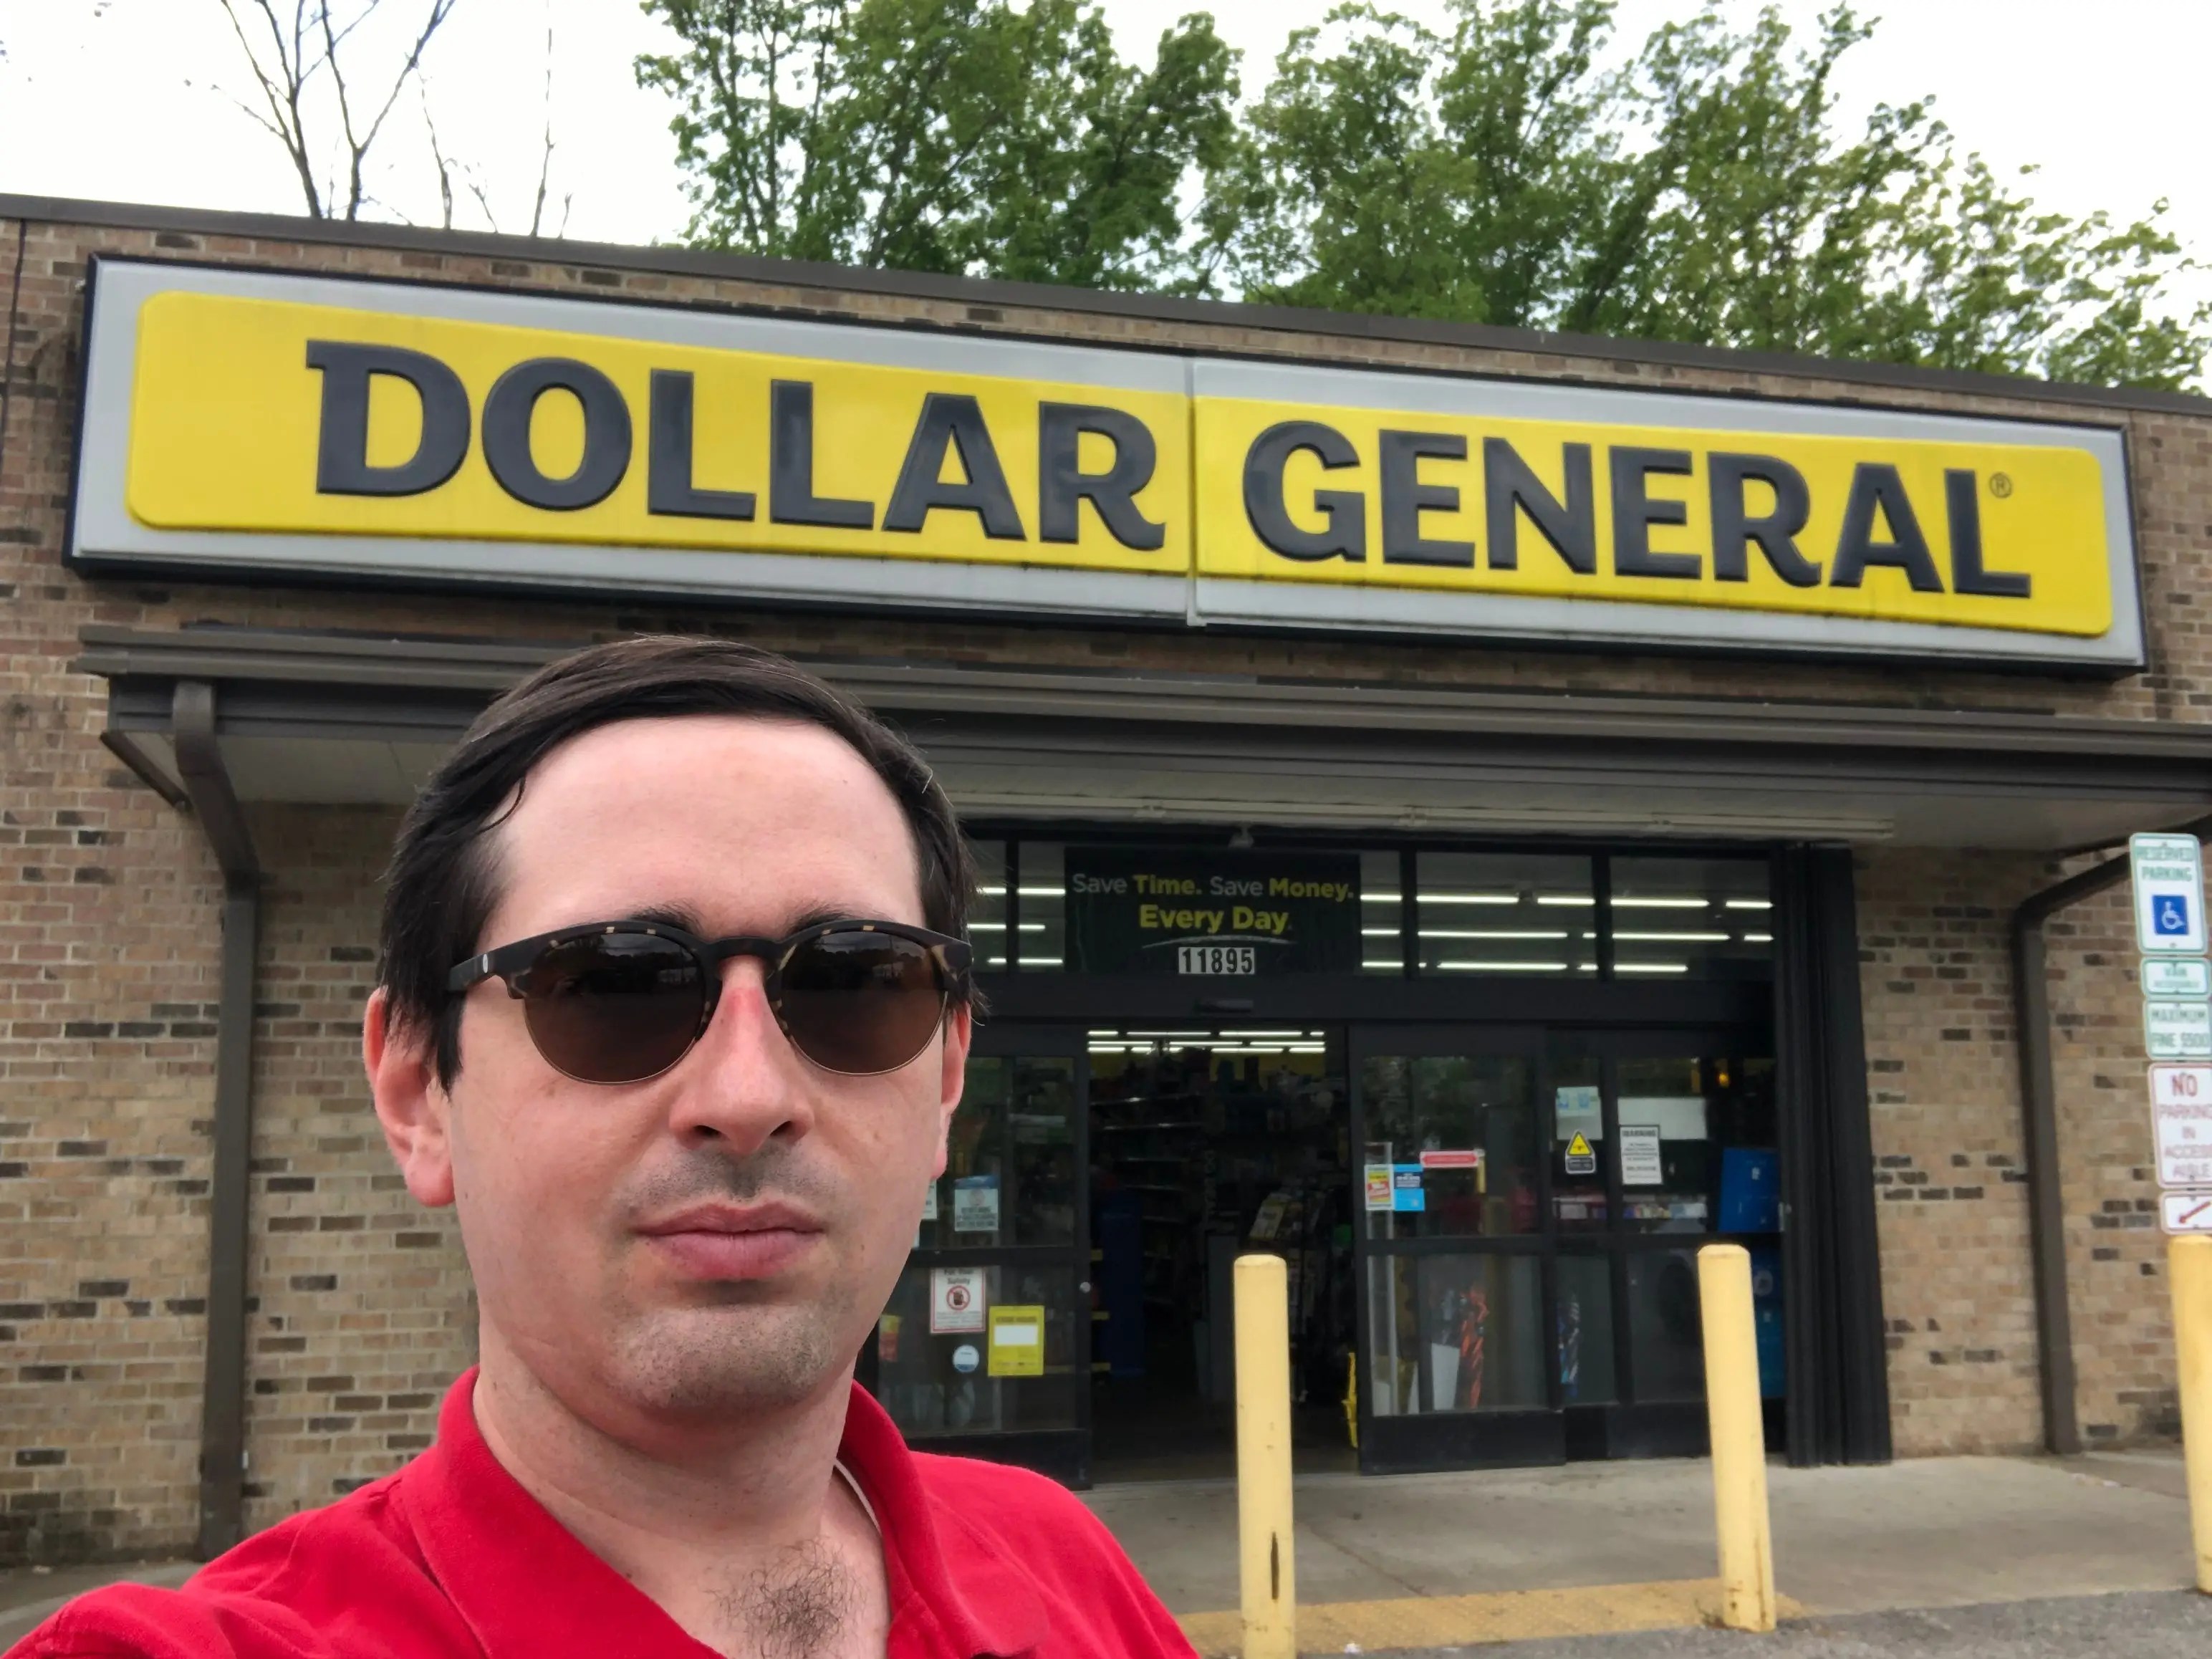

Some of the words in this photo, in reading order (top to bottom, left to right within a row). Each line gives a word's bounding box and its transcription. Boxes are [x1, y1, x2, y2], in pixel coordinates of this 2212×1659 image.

[306, 339, 1167, 552] DOLLAR
[1242, 420, 2032, 599] GENERAL
[2141, 866, 2193, 882] PARKING
[1072, 873, 1127, 894] Save
[1133, 874, 1202, 895] Time.
[1209, 876, 1263, 895] Save
[1269, 877, 1354, 903] Money.
[1140, 904, 1224, 933] Every
[1182, 947, 1253, 973] 11895
[2171, 1074, 2198, 1097] NO
